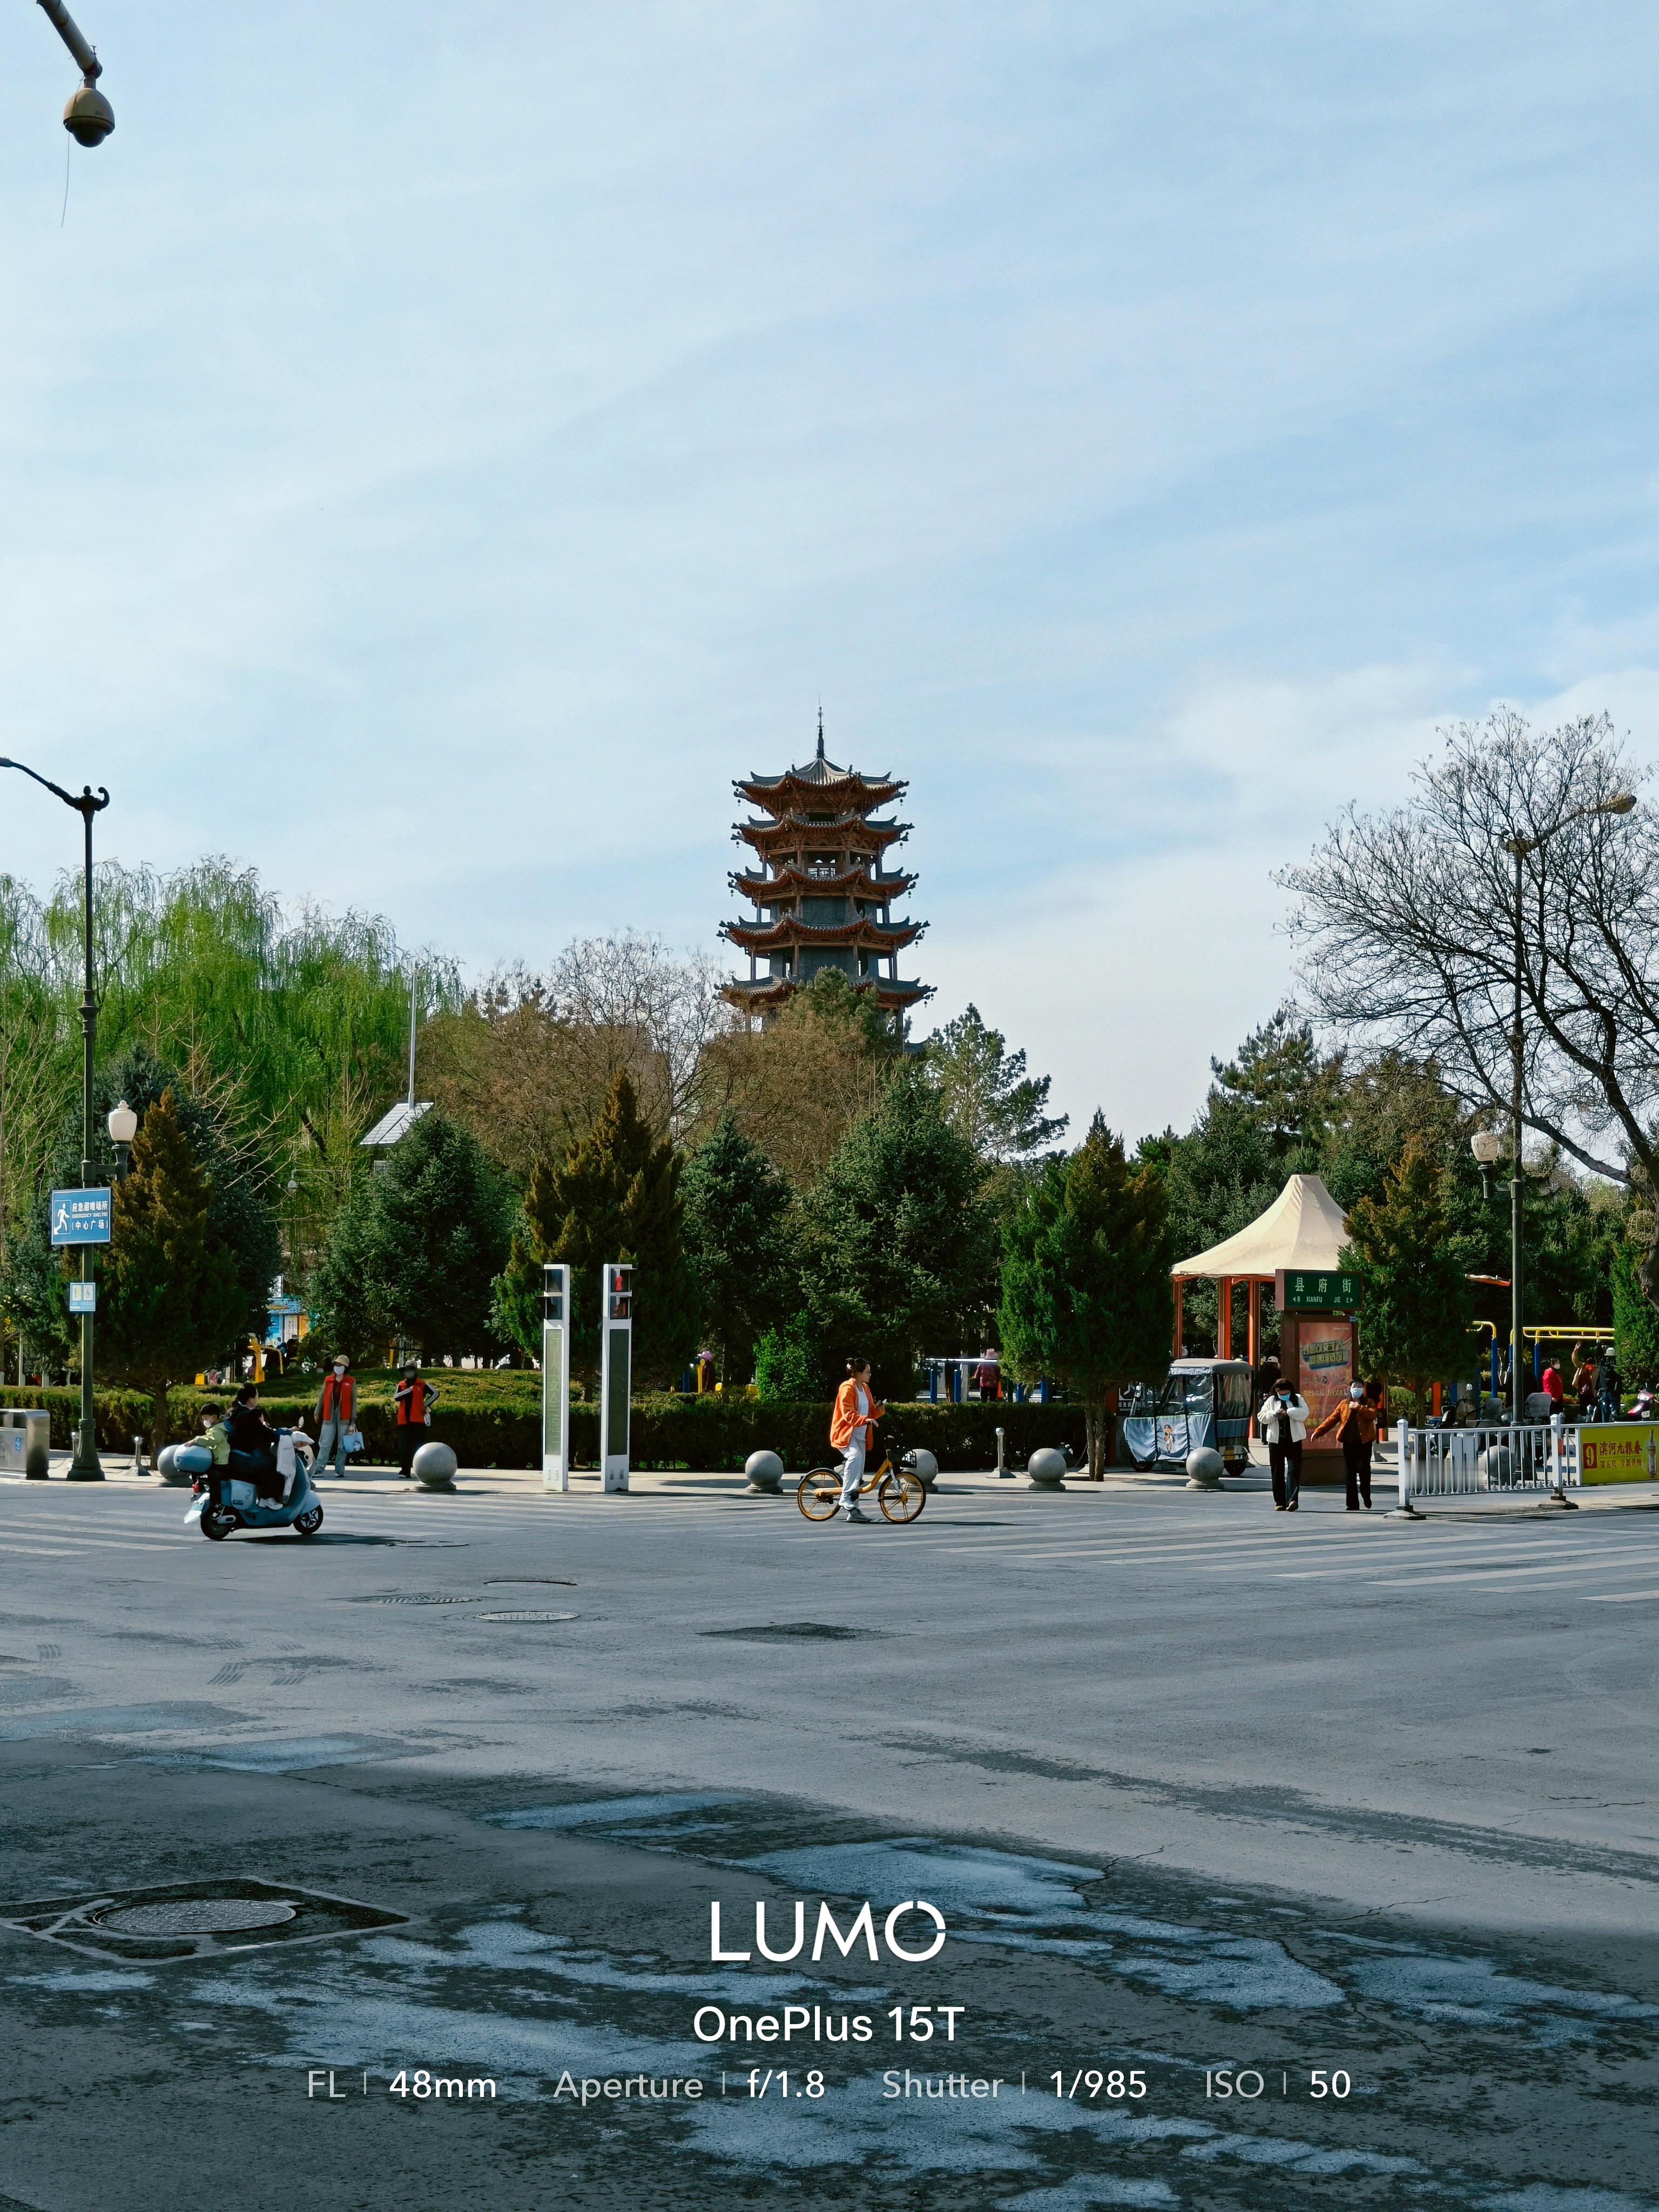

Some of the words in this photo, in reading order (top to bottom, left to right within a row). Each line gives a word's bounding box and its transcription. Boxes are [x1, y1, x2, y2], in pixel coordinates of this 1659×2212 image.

[72, 1201, 108, 1212] 应急避难场所
[1294, 1277, 1352, 1293] 县府街
